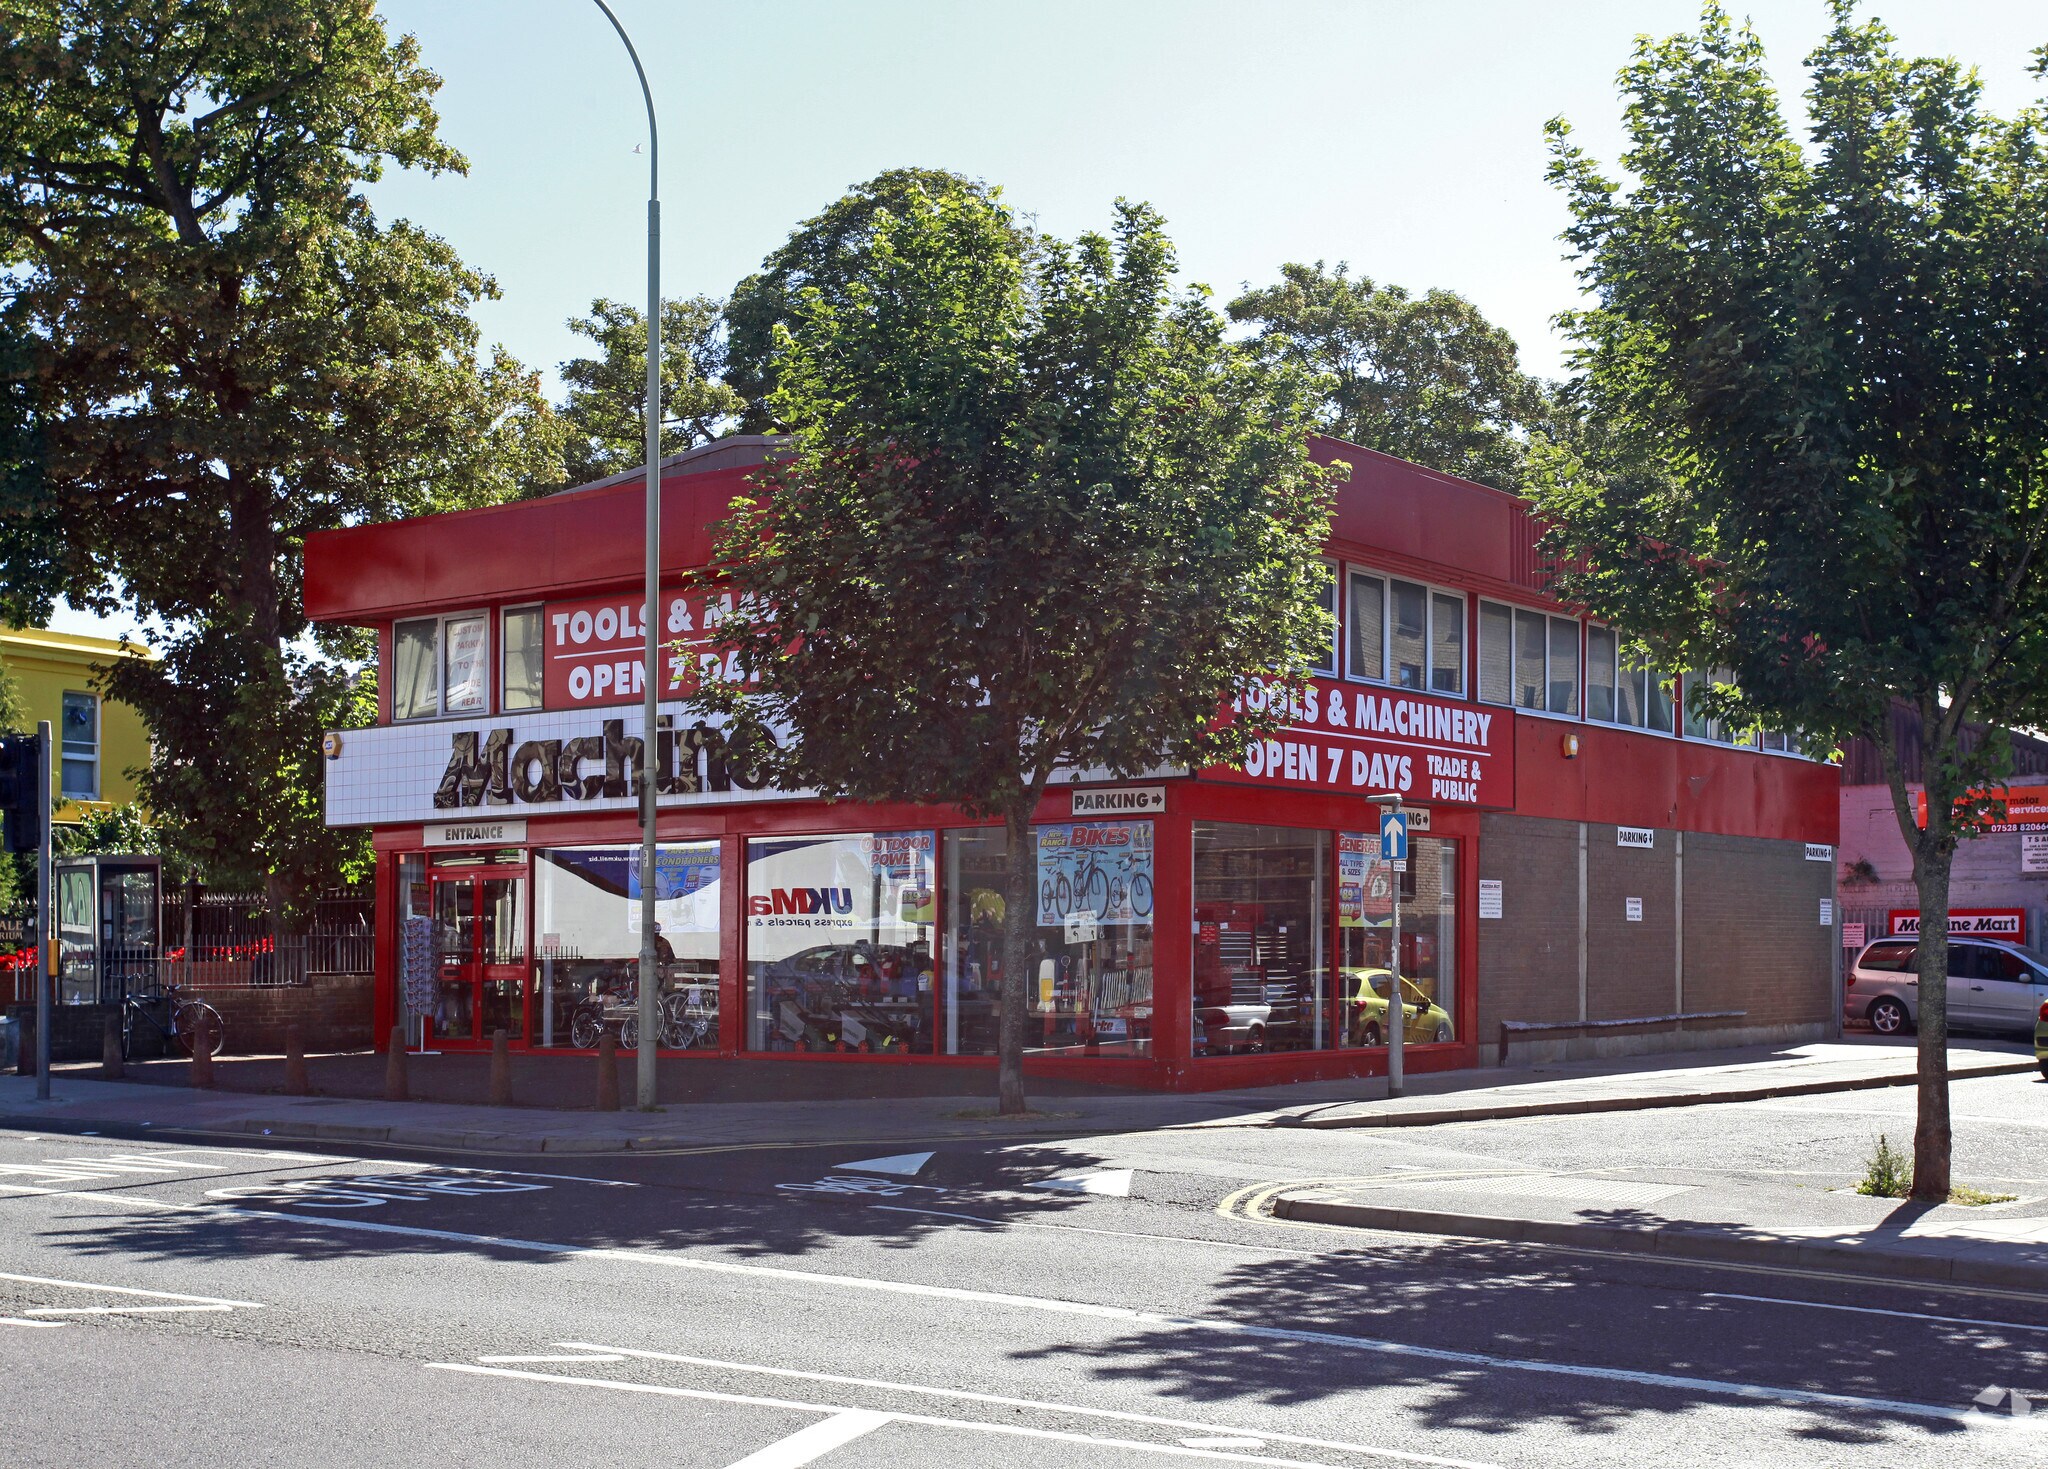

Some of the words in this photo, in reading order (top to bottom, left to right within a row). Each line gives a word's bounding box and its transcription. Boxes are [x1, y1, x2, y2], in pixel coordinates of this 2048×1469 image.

[667, 598, 693, 634] &
[668, 656, 686, 691] 7
[461, 697, 482, 707] REAR
[1327, 689, 1348, 727] &
[1354, 693, 1492, 747] MACHINERY
[1245, 738, 1318, 782] OPEN
[1327, 747, 1344, 784] 7
[1351, 750, 1412, 792] DAYS
[1427, 755, 1467, 779] TRADE
[1471, 760, 1482, 780] &
[1432, 778, 1477, 803] PUBLIC
[1074, 792, 1149, 810] PARKING
[2009, 797, 2039, 805] motor
[445, 825, 503, 841] ENTRANCE
[1991, 823, 2018, 832] 07528
[861, 835, 931, 853] OUTDOOR
[1040, 838, 1067, 846] RANGE
[1070, 827, 1130, 847] BIKES
[1619, 831, 1648, 844] PARKING
[870, 852, 922, 867] POWER
[1806, 846, 1828, 858] PARKING
[655, 855, 720, 865] CONDITIONERS
[1347, 868, 1361, 876] SIZES
[1897, 918, 1971, 932] Mine
[1973, 917, 2016, 931] Mart
